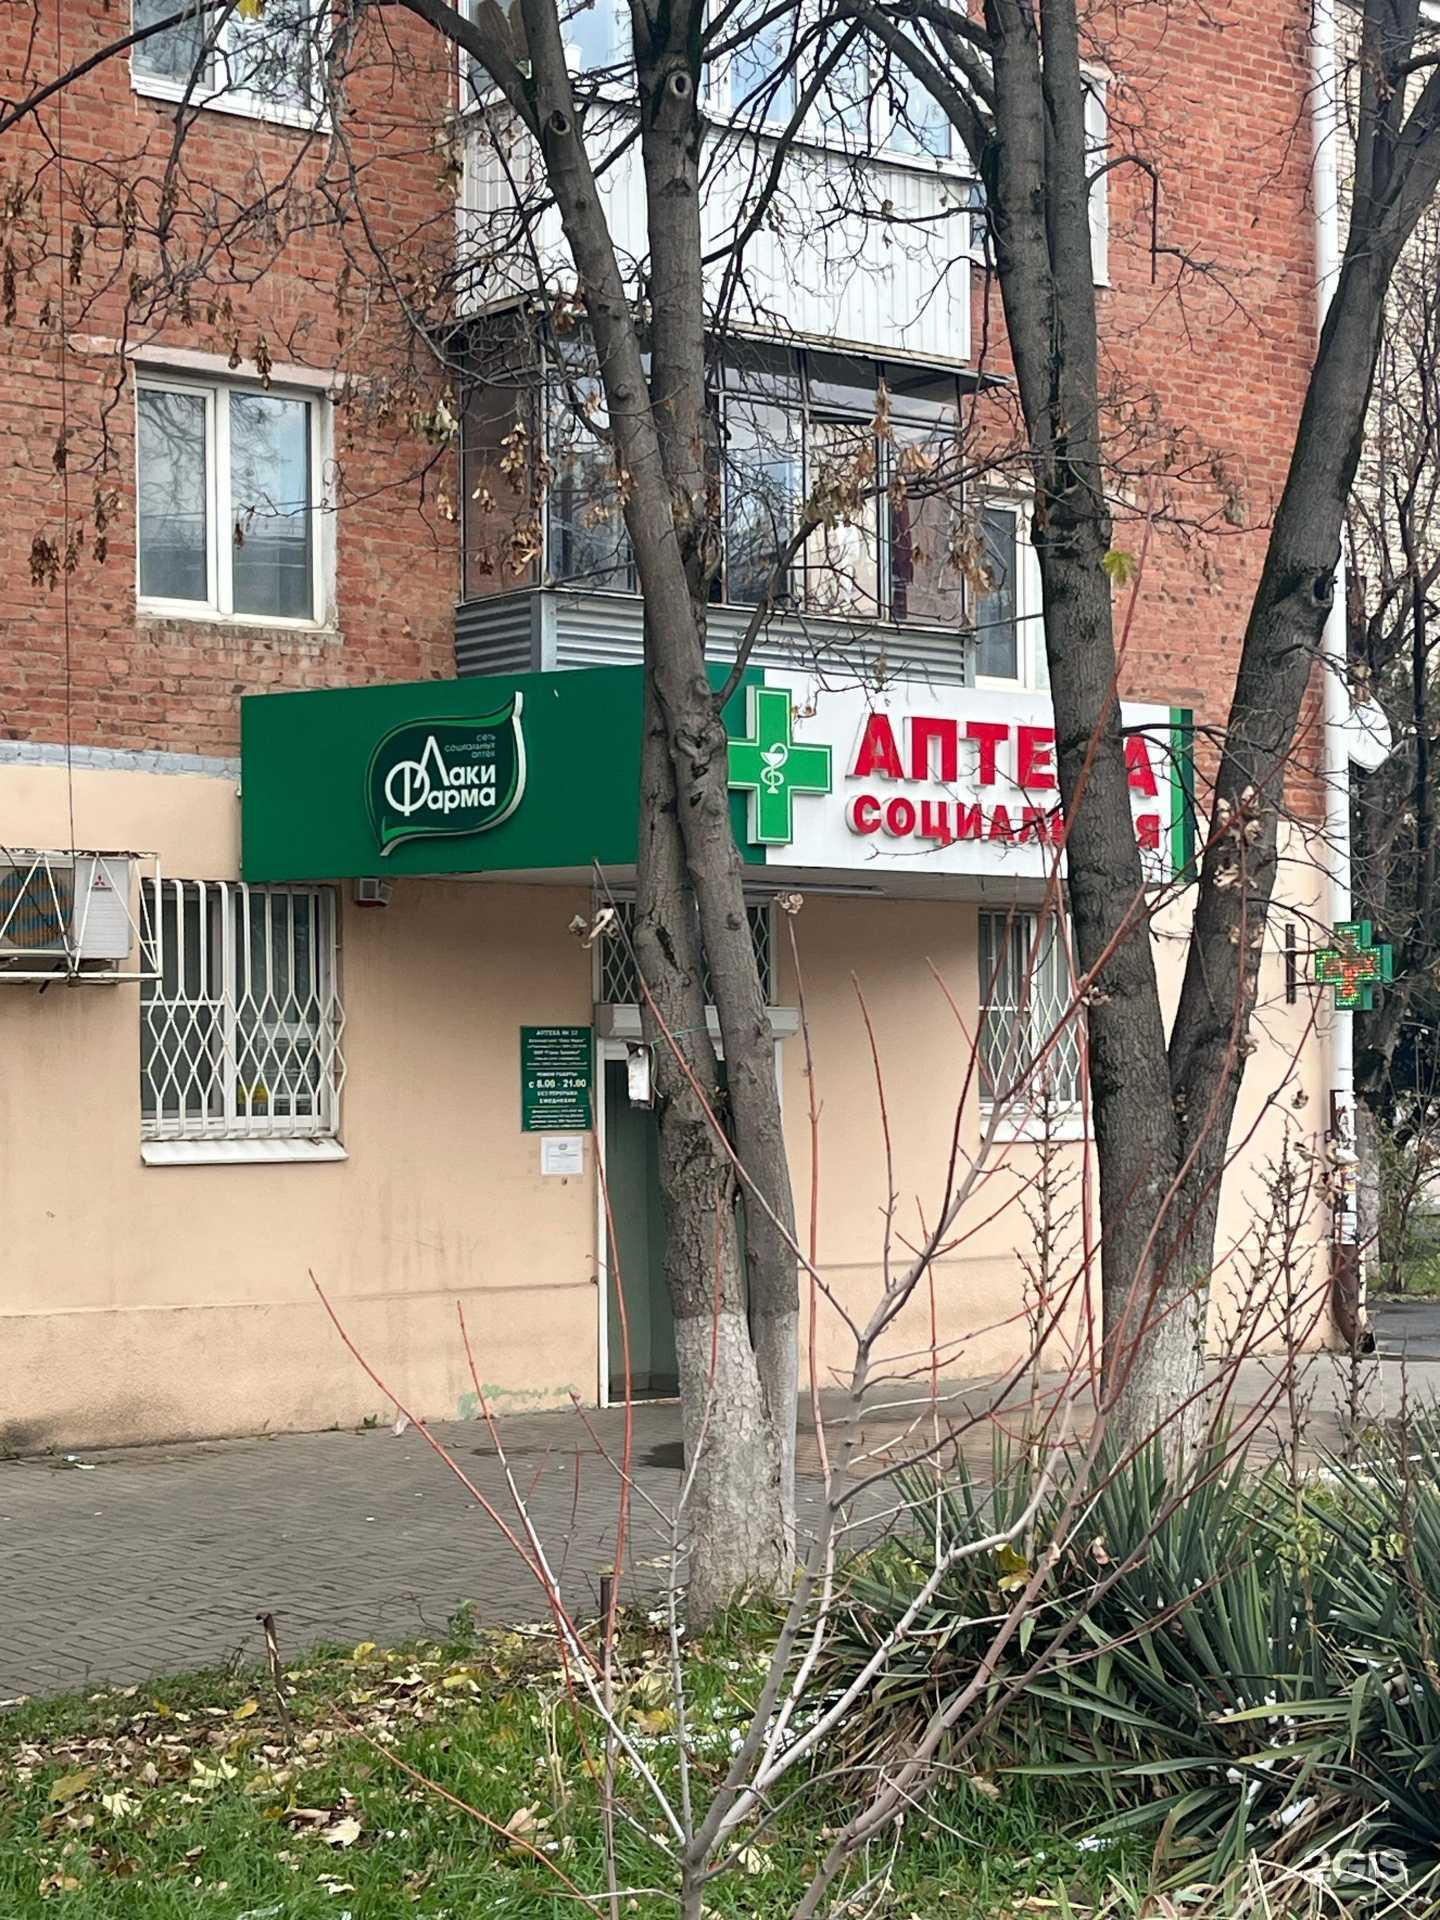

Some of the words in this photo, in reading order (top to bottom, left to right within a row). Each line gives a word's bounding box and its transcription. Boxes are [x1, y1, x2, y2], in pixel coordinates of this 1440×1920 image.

[413, 735, 497, 789] Лаки
[471, 749, 496, 759] аптек
[849, 713, 1159, 797] АПТЕА
[384, 760, 497, 817] Фарма
[849, 794, 1161, 850] СОЦИАЛЬЯ
[536, 1079, 556, 1088] 8.00
[562, 1079, 587, 1088] 21.00
